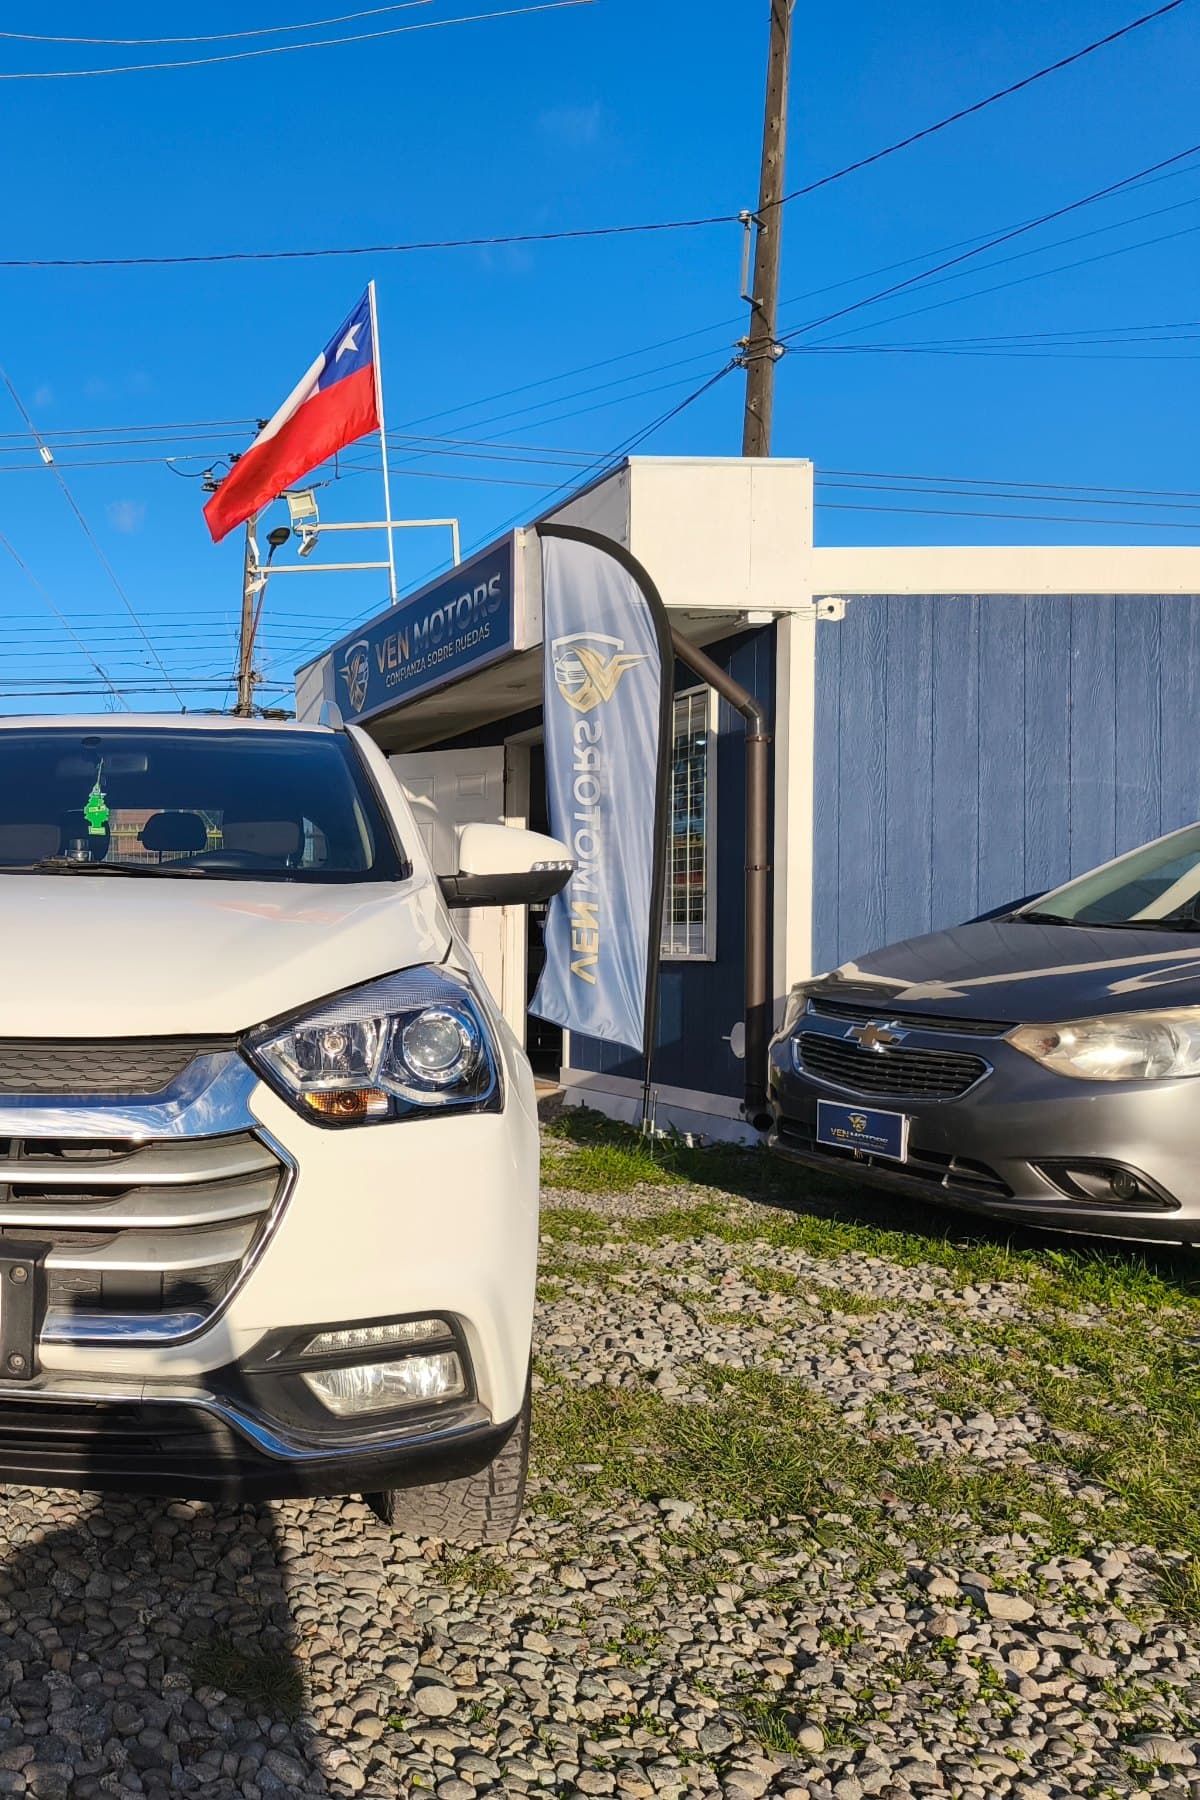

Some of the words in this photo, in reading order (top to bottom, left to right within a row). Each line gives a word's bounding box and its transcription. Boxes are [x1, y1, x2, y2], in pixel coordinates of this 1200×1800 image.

[375, 625, 410, 673] VEN
[413, 571, 501, 655] MOTORS
[385, 657, 426, 688] CONFIANZA
[427, 642, 455, 668] SOBRE
[455, 622, 490, 650] RUEDAS
[830, 1127, 849, 1138] VEN
